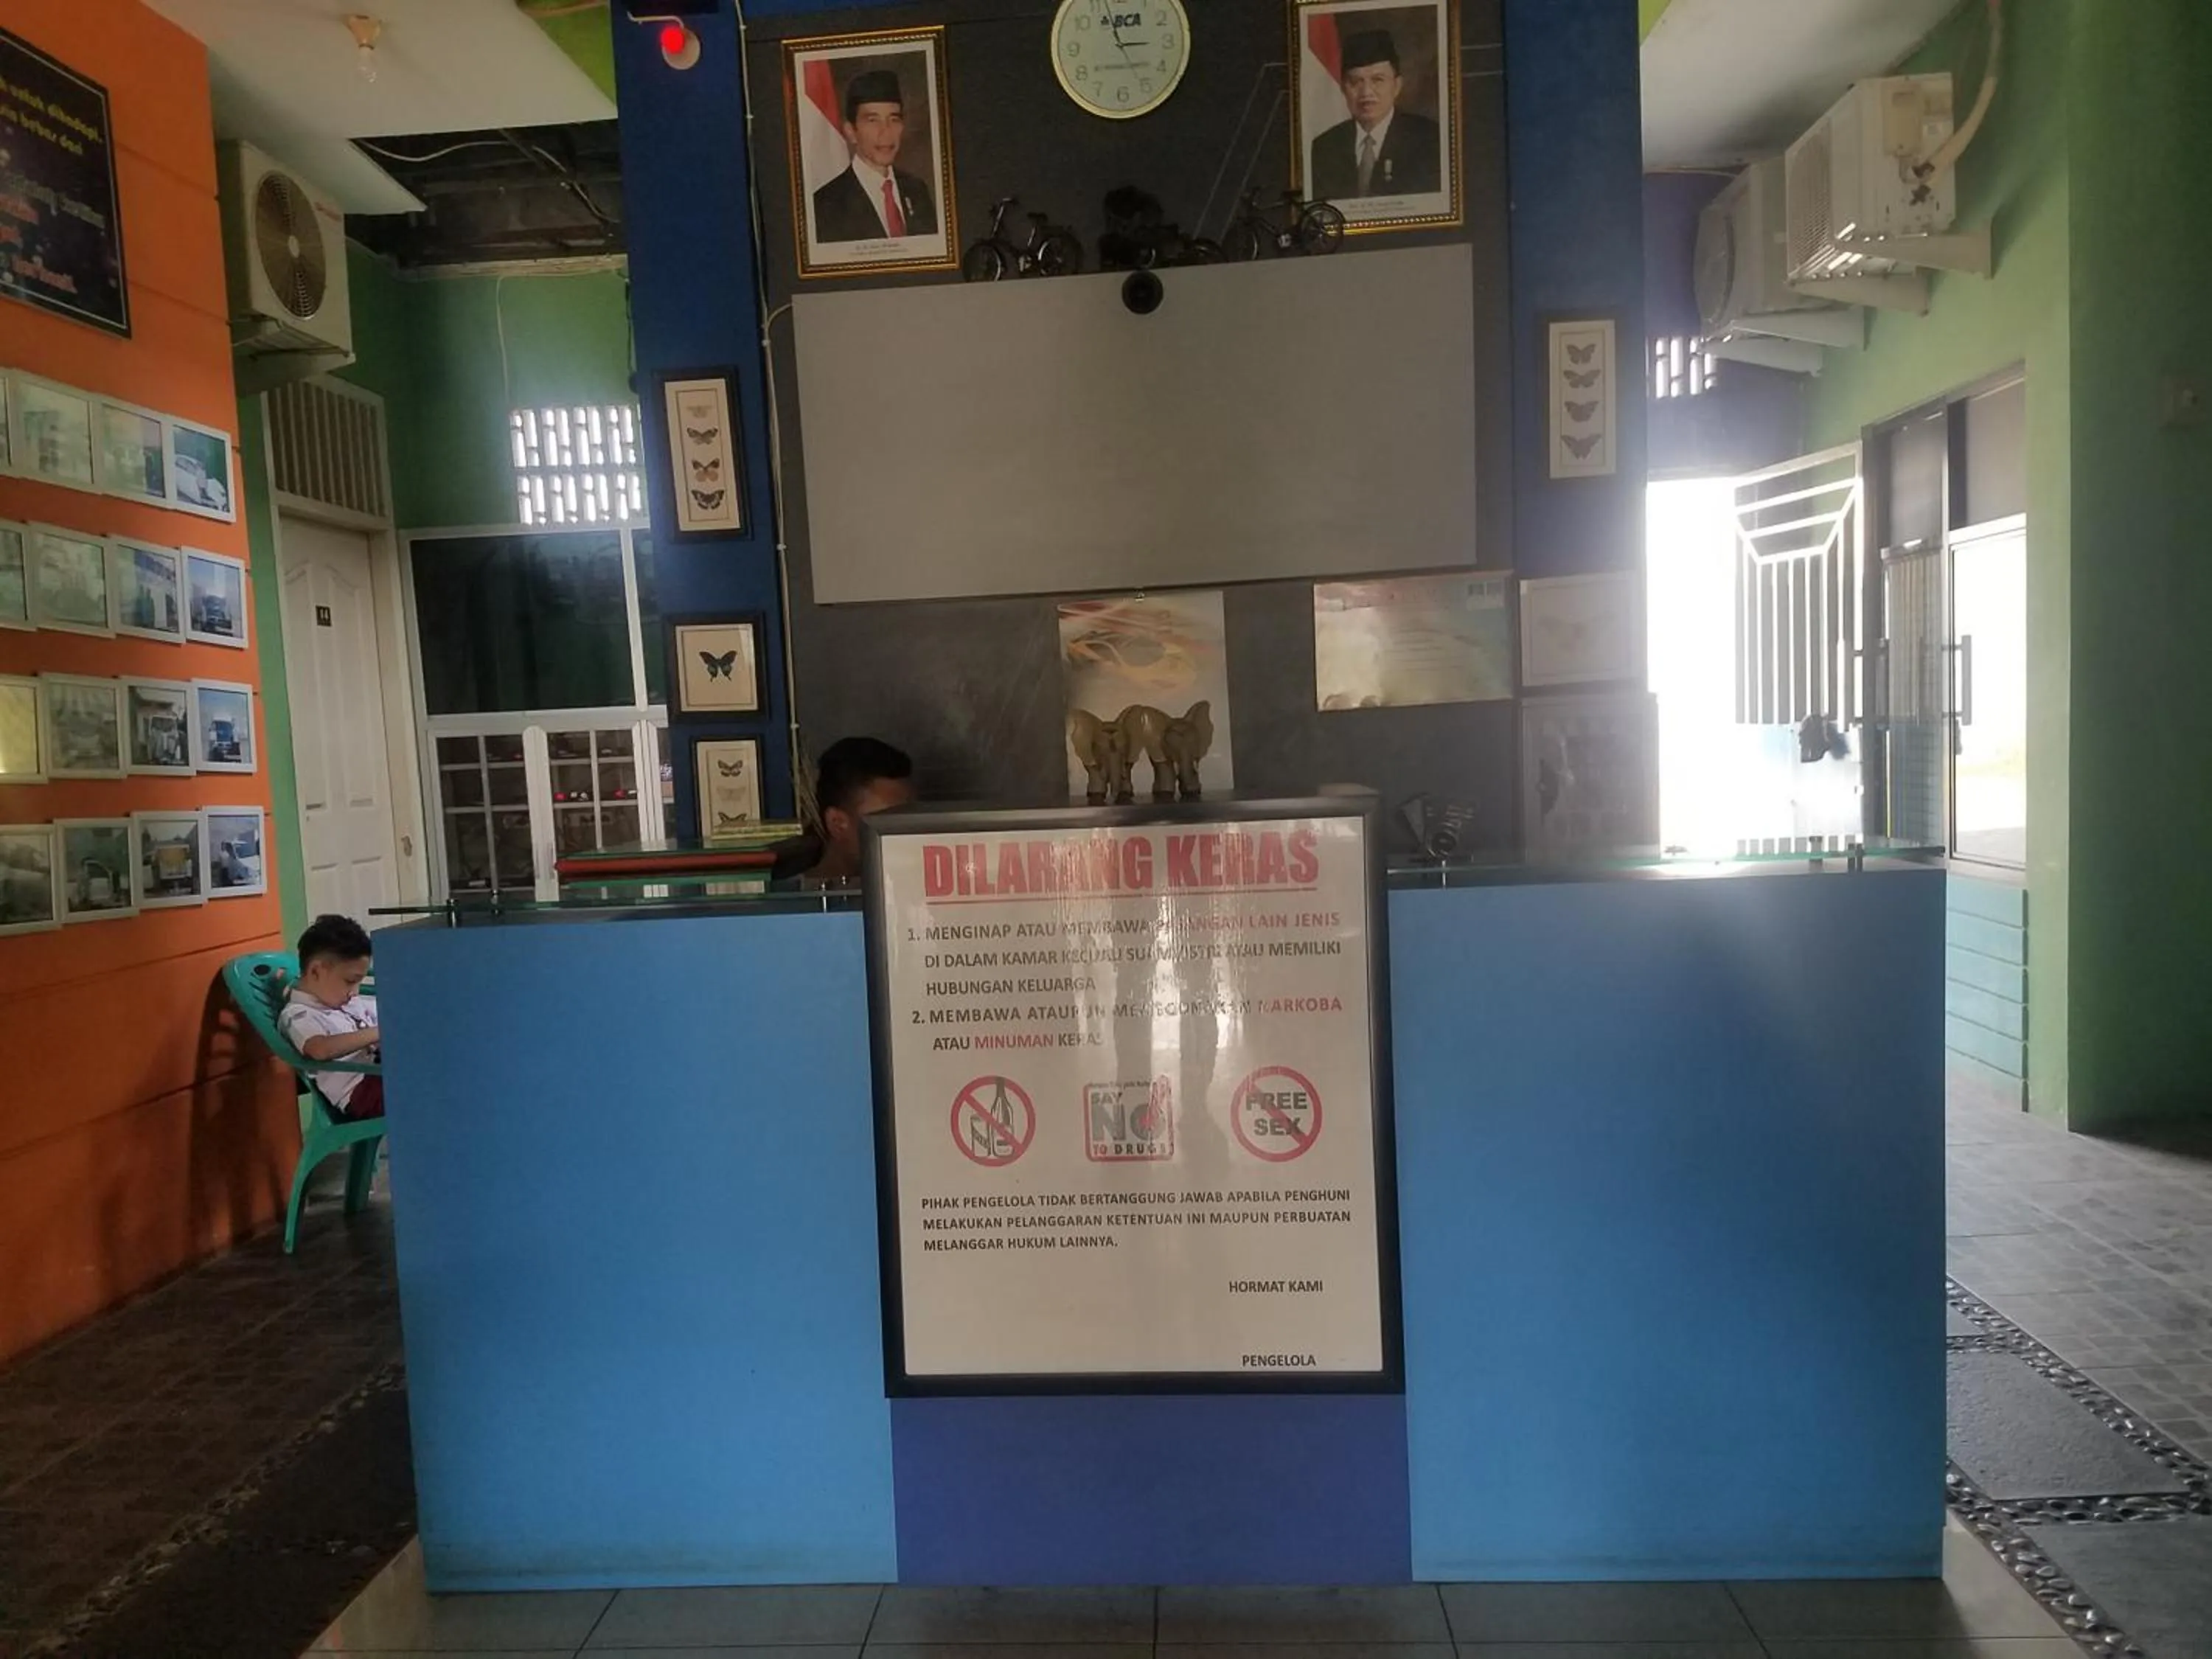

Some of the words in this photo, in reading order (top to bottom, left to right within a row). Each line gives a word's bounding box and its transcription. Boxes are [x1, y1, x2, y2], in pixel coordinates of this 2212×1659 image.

[1114, 13, 1141, 27] BCA
[1155, 10, 1166, 27] 2
[1067, 42, 1080, 57] 9
[1076, 65, 1088, 80] 8
[1156, 60, 1166, 72] 4
[1117, 87, 1129, 102] 6
[922, 835, 1152, 897] DILARANG
[1166, 829, 1319, 888] KERAS
[908, 928, 920, 942] 1.
[925, 925, 1012, 940] MENGINAP
[1016, 923, 1056, 937] ATAU
[1062, 919, 1152, 935] MEMBAWA
[1155, 915, 1243, 933] PSANGAN
[1250, 914, 1287, 928] LAIN
[1295, 911, 1340, 926] JENIS
[925, 954, 940, 968] DI
[945, 953, 998, 967] DALAM
[1002, 950, 1057, 965] KAMAR
[1225, 942, 1265, 958] ATAU
[1269, 941, 1341, 956] MEMILIKI
[926, 980, 1013, 995] HUBUNGAN
[1018, 977, 1096, 992] KELUARGA
[912, 1010, 925, 1024] 2.
[930, 1007, 1021, 1023] MEMBAWA
[1258, 998, 1342, 1014] NARKOBA
[932, 1037, 970, 1051] ATAU
[975, 1034, 1054, 1048] MINUMAN
[1245, 1092, 1307, 1110] FREE
[1253, 1117, 1302, 1136] SEX
[1093, 1144, 1107, 1155] TO
[922, 1197, 959, 1209] PIHAK
[963, 1195, 1035, 1208] PENGELOLA
[1038, 1194, 1076, 1206] TIDAK
[1080, 1192, 1176, 1206] BERTANGGUNG
[1180, 1191, 1223, 1203] JAWAB
[1227, 1190, 1281, 1203] APABILA
[1284, 1189, 1350, 1202] PENGHUNI
[922, 1217, 1003, 1231] MELAKUKAN
[1006, 1214, 1102, 1228] PELANGGARAN
[1107, 1213, 1182, 1226] KETENTUAN
[1187, 1213, 1206, 1225] INI
[1210, 1211, 1270, 1225] MAUPUN
[1274, 1210, 1351, 1223] PERBUATAN
[923, 1238, 1004, 1251] MELANGGAR
[1007, 1237, 1056, 1250] HUKUM
[1060, 1235, 1119, 1248] LAINNYA.
[1229, 1280, 1285, 1293] HORMAT
[1288, 1279, 1324, 1293] KAMI
[1242, 1354, 1318, 1367] PENGELOLA
